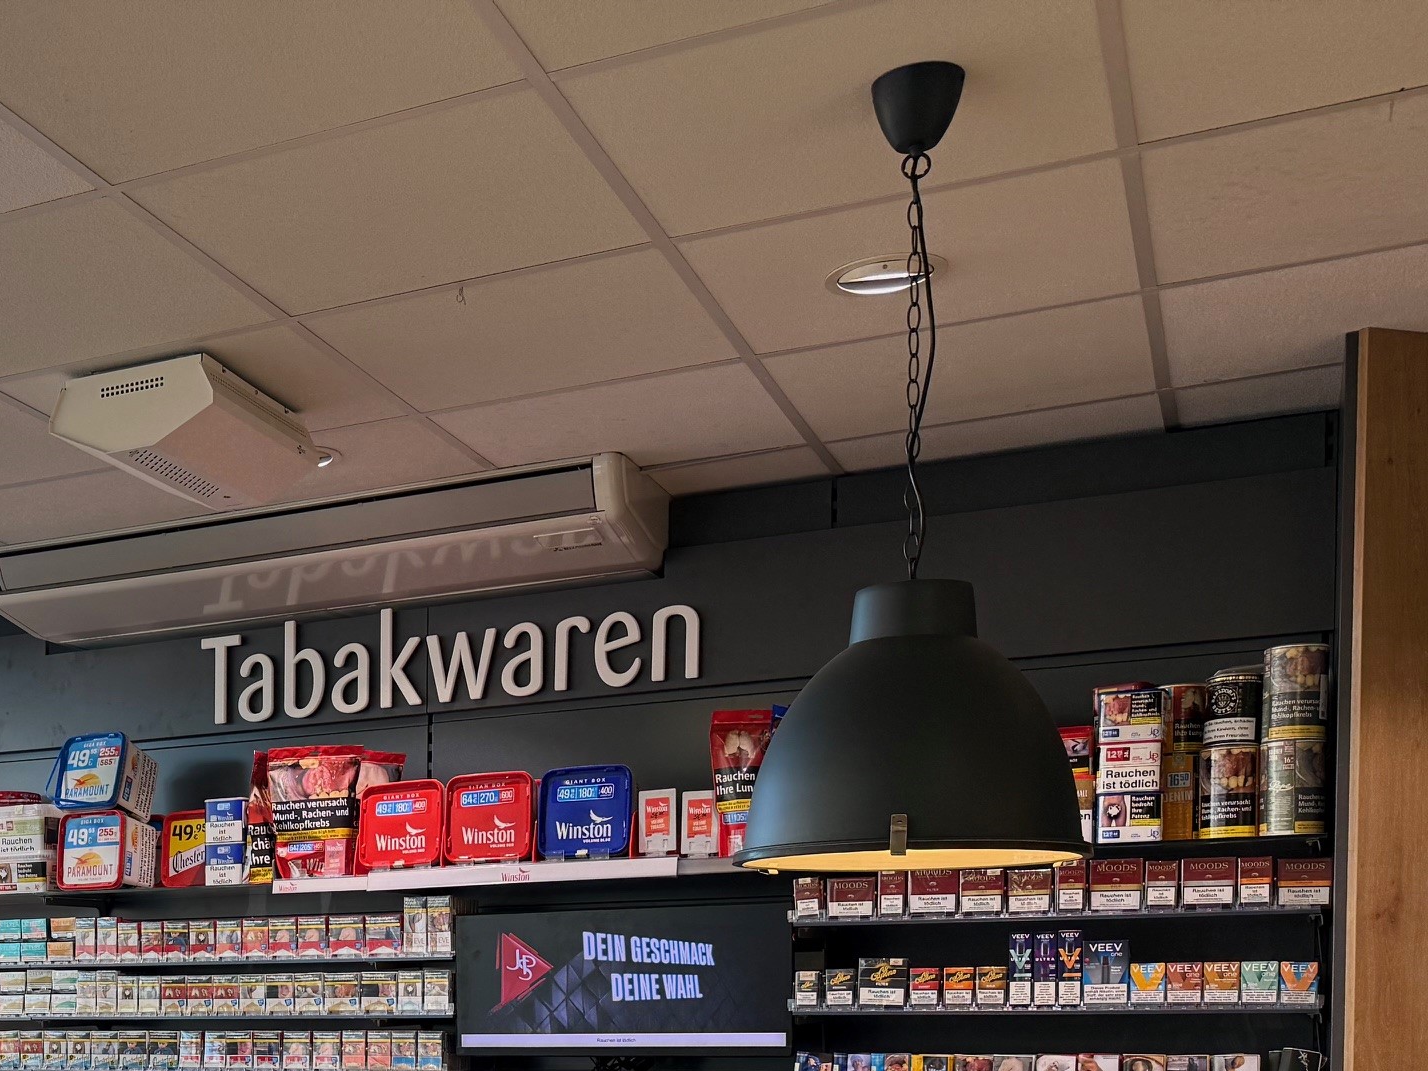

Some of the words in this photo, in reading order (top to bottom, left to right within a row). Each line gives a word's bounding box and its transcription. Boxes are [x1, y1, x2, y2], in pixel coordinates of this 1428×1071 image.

[201, 604, 700, 725] Tabakwaren
[715, 771, 756, 784] Rauchen
[1106, 769, 1156, 778] Rauchen
[1102, 781, 1114, 789] ist
[1120, 780, 1158, 789] tödlich
[65, 784, 110, 798] PARAMOUNT
[717, 785, 733, 795] Ihre
[272, 802, 304, 812] Rauchen
[307, 799, 347, 809] verursacht
[273, 812, 299, 821] Mund-,
[302, 810, 333, 819] Rachen-
[336, 808, 348, 816] und
[462, 827, 514, 844] Winston
[556, 822, 611, 840] Winston
[375, 833, 425, 851] Winston
[1097, 863, 1137, 872] MOODS
[1190, 862, 1229, 870] MOODS
[1285, 862, 1325, 870] MOODS
[67, 864, 113, 878] PARAMOUNT
[501, 873, 529, 881] Winston
[583, 931, 626, 962] DEIN
[630, 936, 715, 966] GESCHMACK
[1089, 943, 1122, 952] VEEV
[1132, 965, 1163, 973] VEEV
[1168, 964, 1200, 972] VEEV
[1205, 964, 1238, 972] VEEV
[1244, 963, 1277, 971] VEEV
[1283, 964, 1316, 973] VEEV
[611, 973, 661, 1001] DEINE
[663, 974, 703, 999] WAHL
